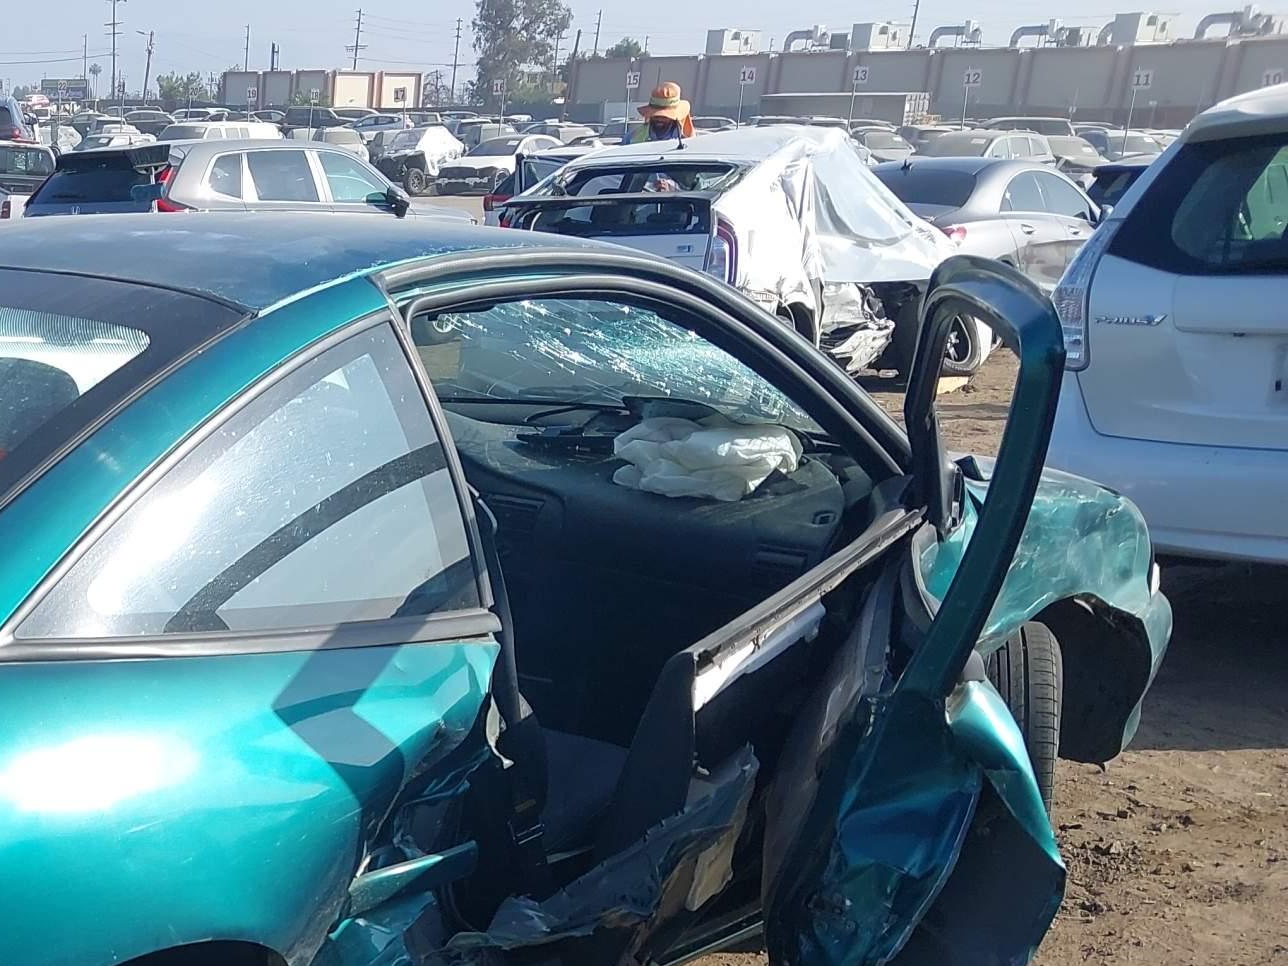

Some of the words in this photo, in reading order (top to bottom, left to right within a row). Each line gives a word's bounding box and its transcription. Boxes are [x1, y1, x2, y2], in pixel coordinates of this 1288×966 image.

[627, 74, 639, 85] 15
[741, 70, 754, 81] 14
[854, 70, 868, 81] 13
[964, 72, 980, 84] 12
[1135, 74, 1150, 86] 11
[1263, 72, 1282, 87] 10
[394, 90, 405, 101] 17
